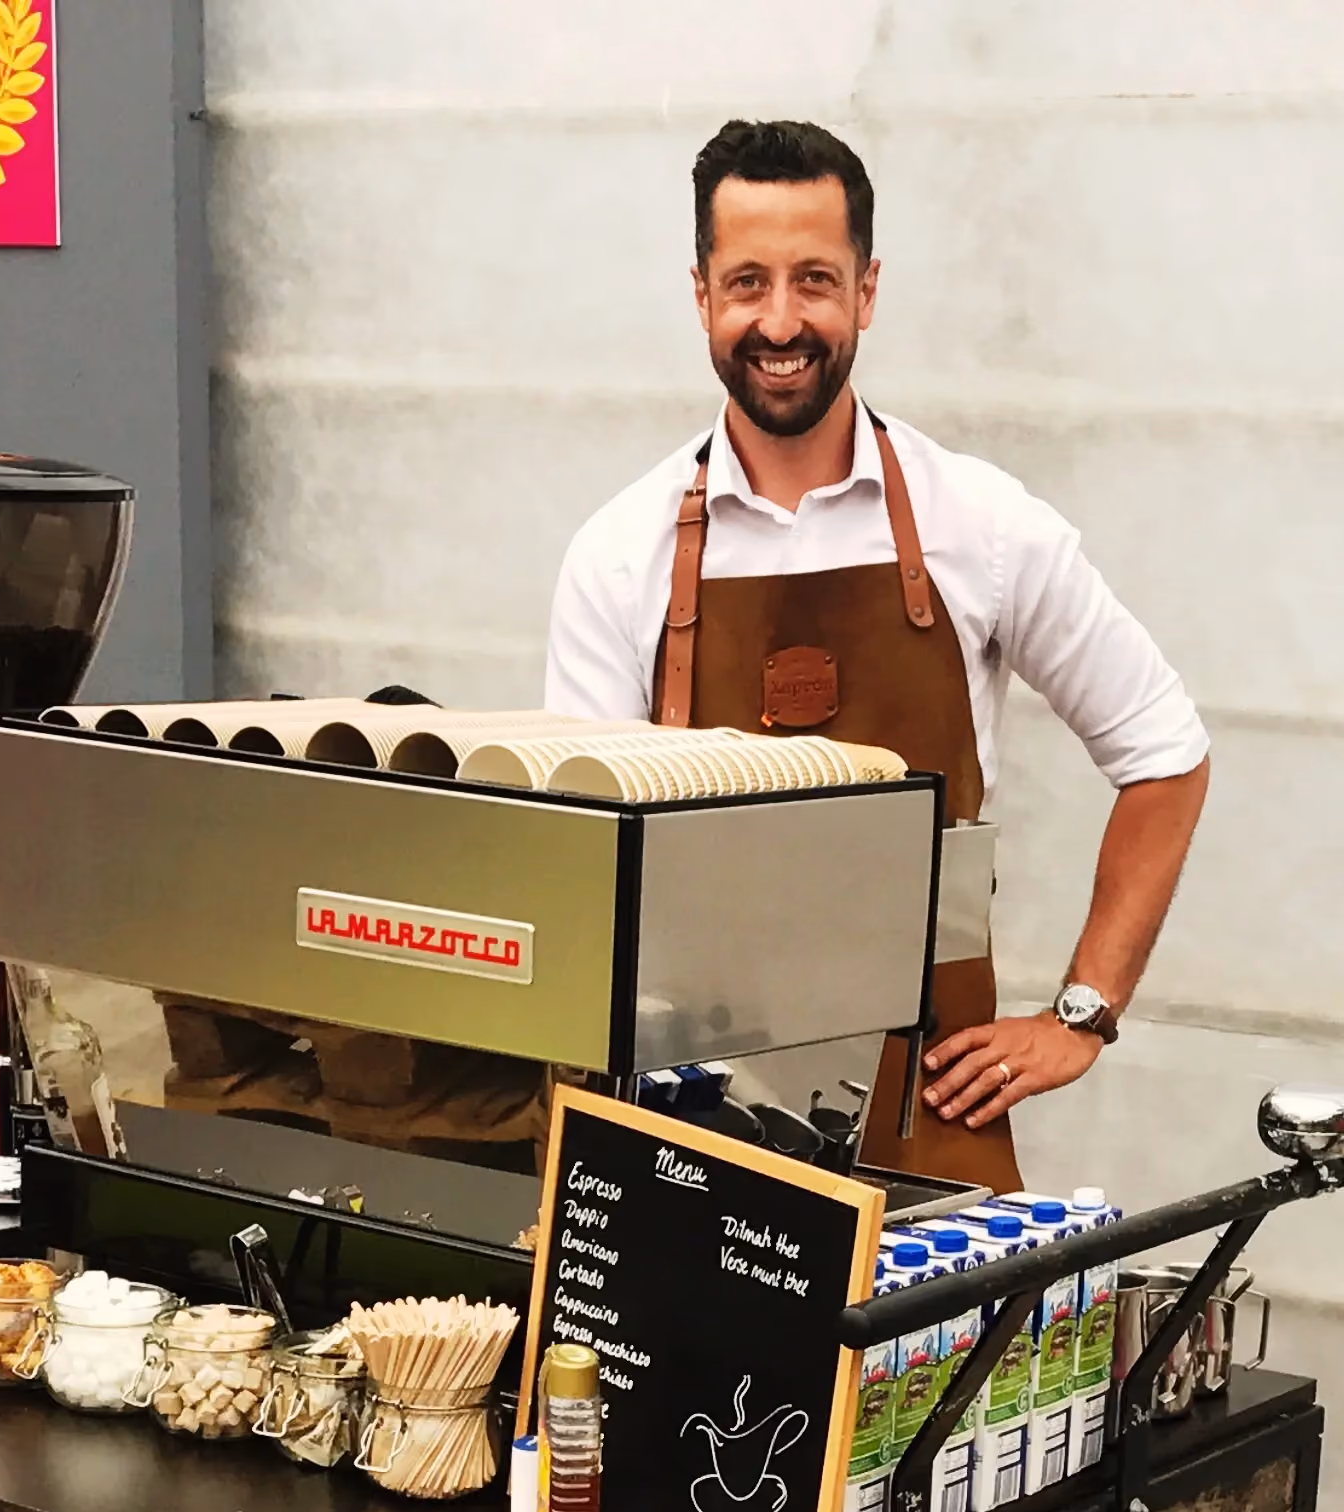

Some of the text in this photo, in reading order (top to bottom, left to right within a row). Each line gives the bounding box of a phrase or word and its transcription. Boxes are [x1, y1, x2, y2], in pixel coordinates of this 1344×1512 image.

[567, 1161, 623, 1201] Espresso
[655, 1146, 708, 1184] Menu
[564, 1199, 609, 1230] Doppio
[561, 1228, 619, 1266] Americano
[721, 1215, 801, 1259] Dilmah thee
[558, 1258, 605, 1290] Cortado
[720, 1245, 810, 1298] Verse munt thee
[554, 1285, 619, 1326] Cappuccino
[553, 1313, 651, 1368] Espresso macchiato
[599, 1365, 634, 1391] chiato
